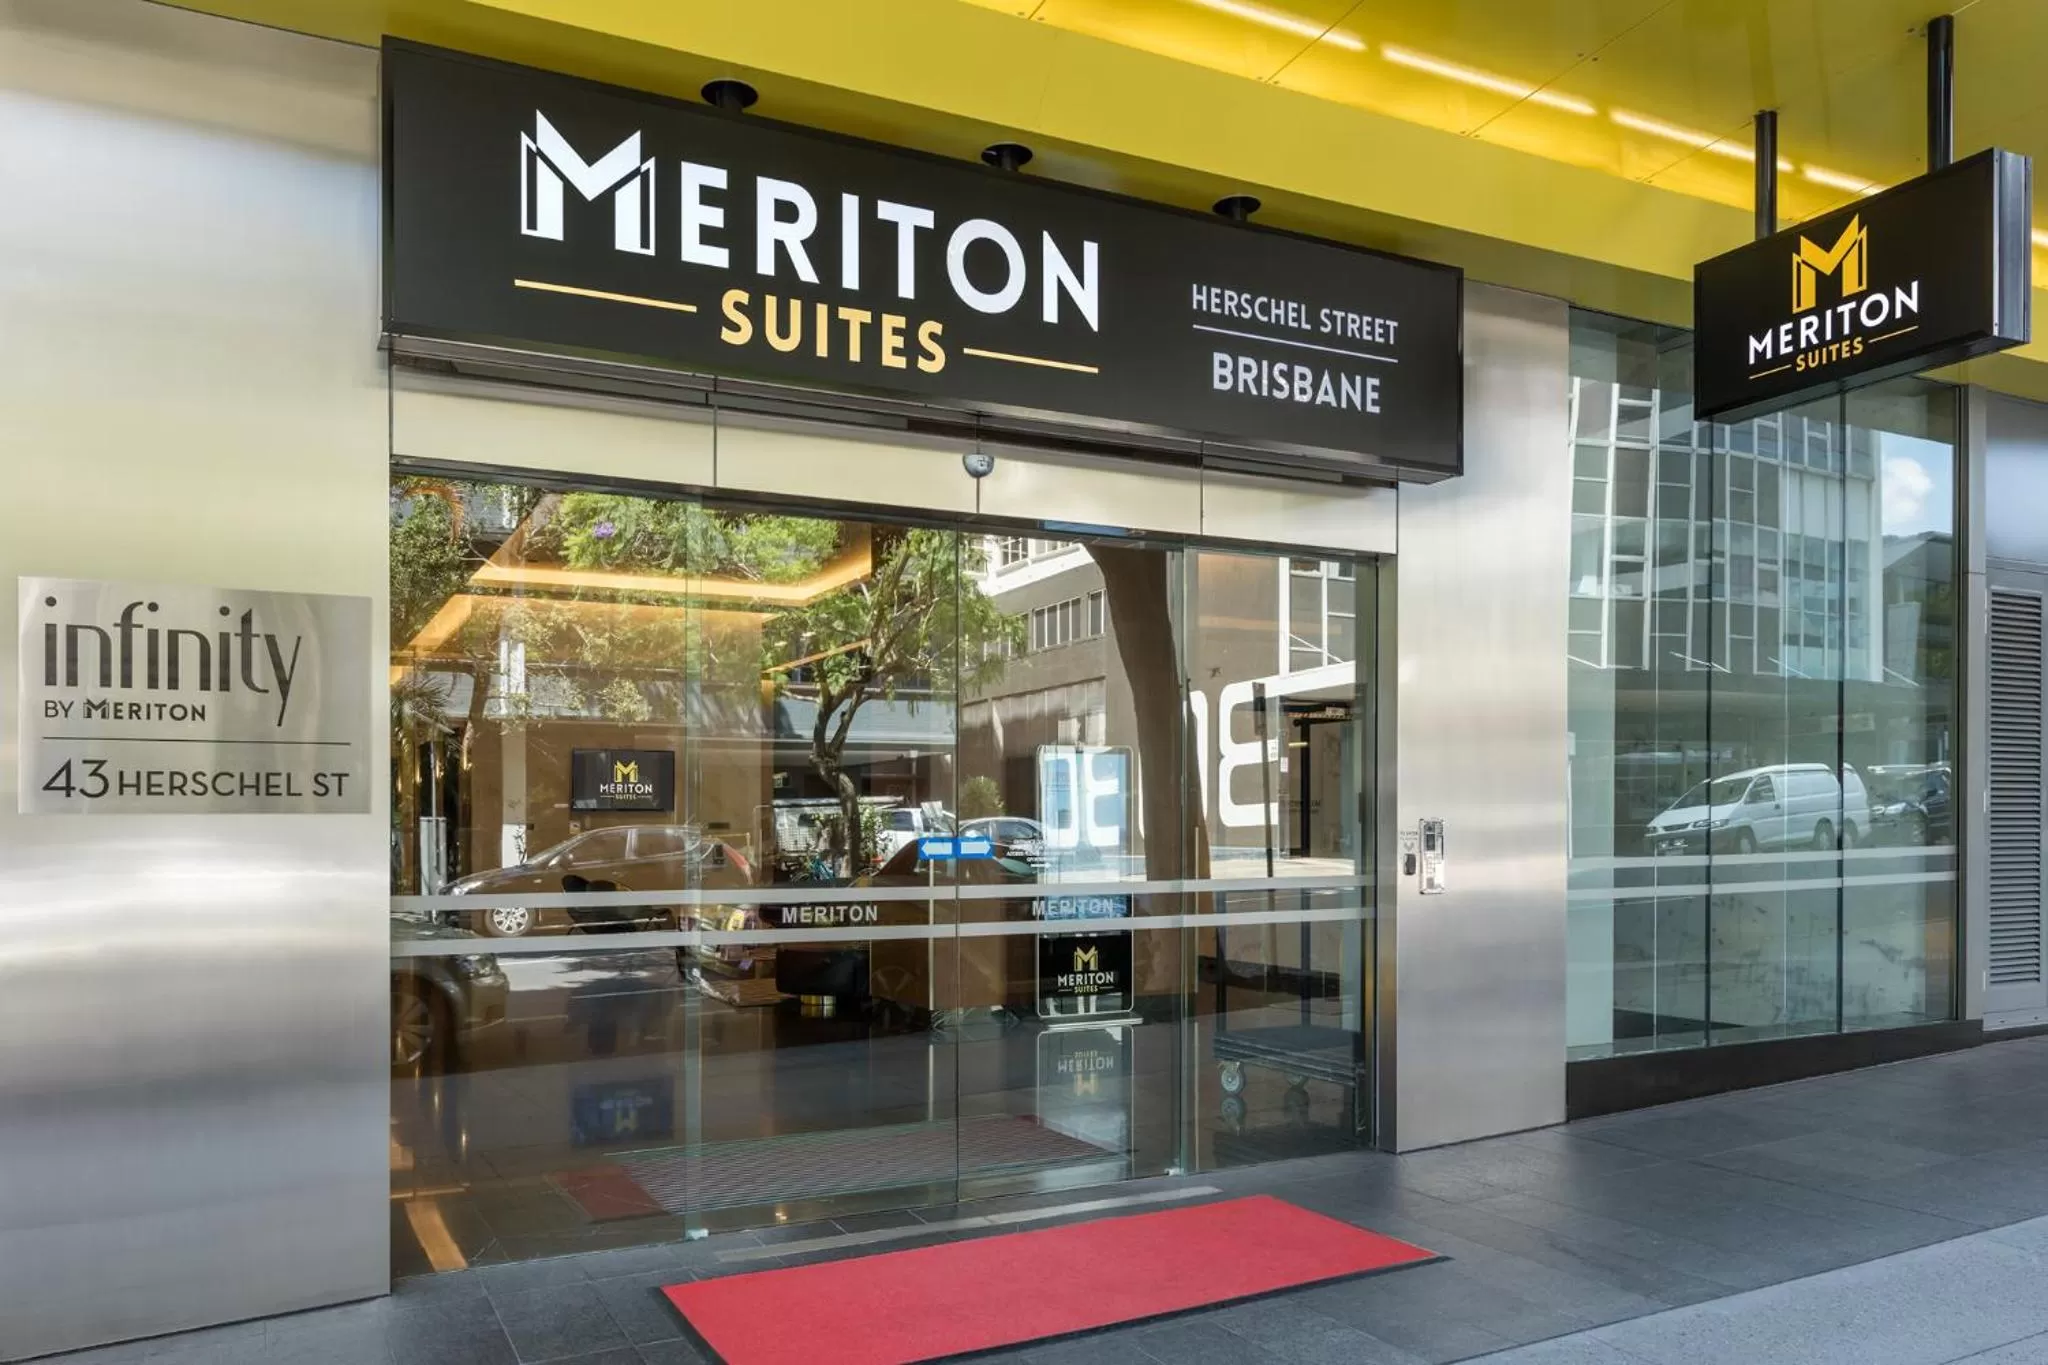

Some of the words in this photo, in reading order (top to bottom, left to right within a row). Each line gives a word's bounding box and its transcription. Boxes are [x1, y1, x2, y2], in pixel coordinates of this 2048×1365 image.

[521, 109, 1099, 332] MERITON
[720, 289, 947, 373] SUITES
[1192, 283, 1311, 330] HERSCHEL
[1320, 308, 1399, 345] STREET
[1748, 280, 1919, 365] MERITON
[1796, 337, 1864, 372] SUITES
[1213, 351, 1381, 414] BRISBANE
[44, 596, 302, 727] infinity
[44, 700, 75, 718] BY
[83, 698, 206, 722] MERITON
[42, 759, 109, 798] 43
[118, 770, 303, 797] HERSCHEL
[312, 772, 350, 797] ST
[600, 783, 653, 794] MERITON
[782, 905, 878, 924] MERITON
[1032, 898, 1114, 917] MERITON
[1057, 971, 1114, 987] MERITON
[1074, 984, 1098, 993] SUITES
